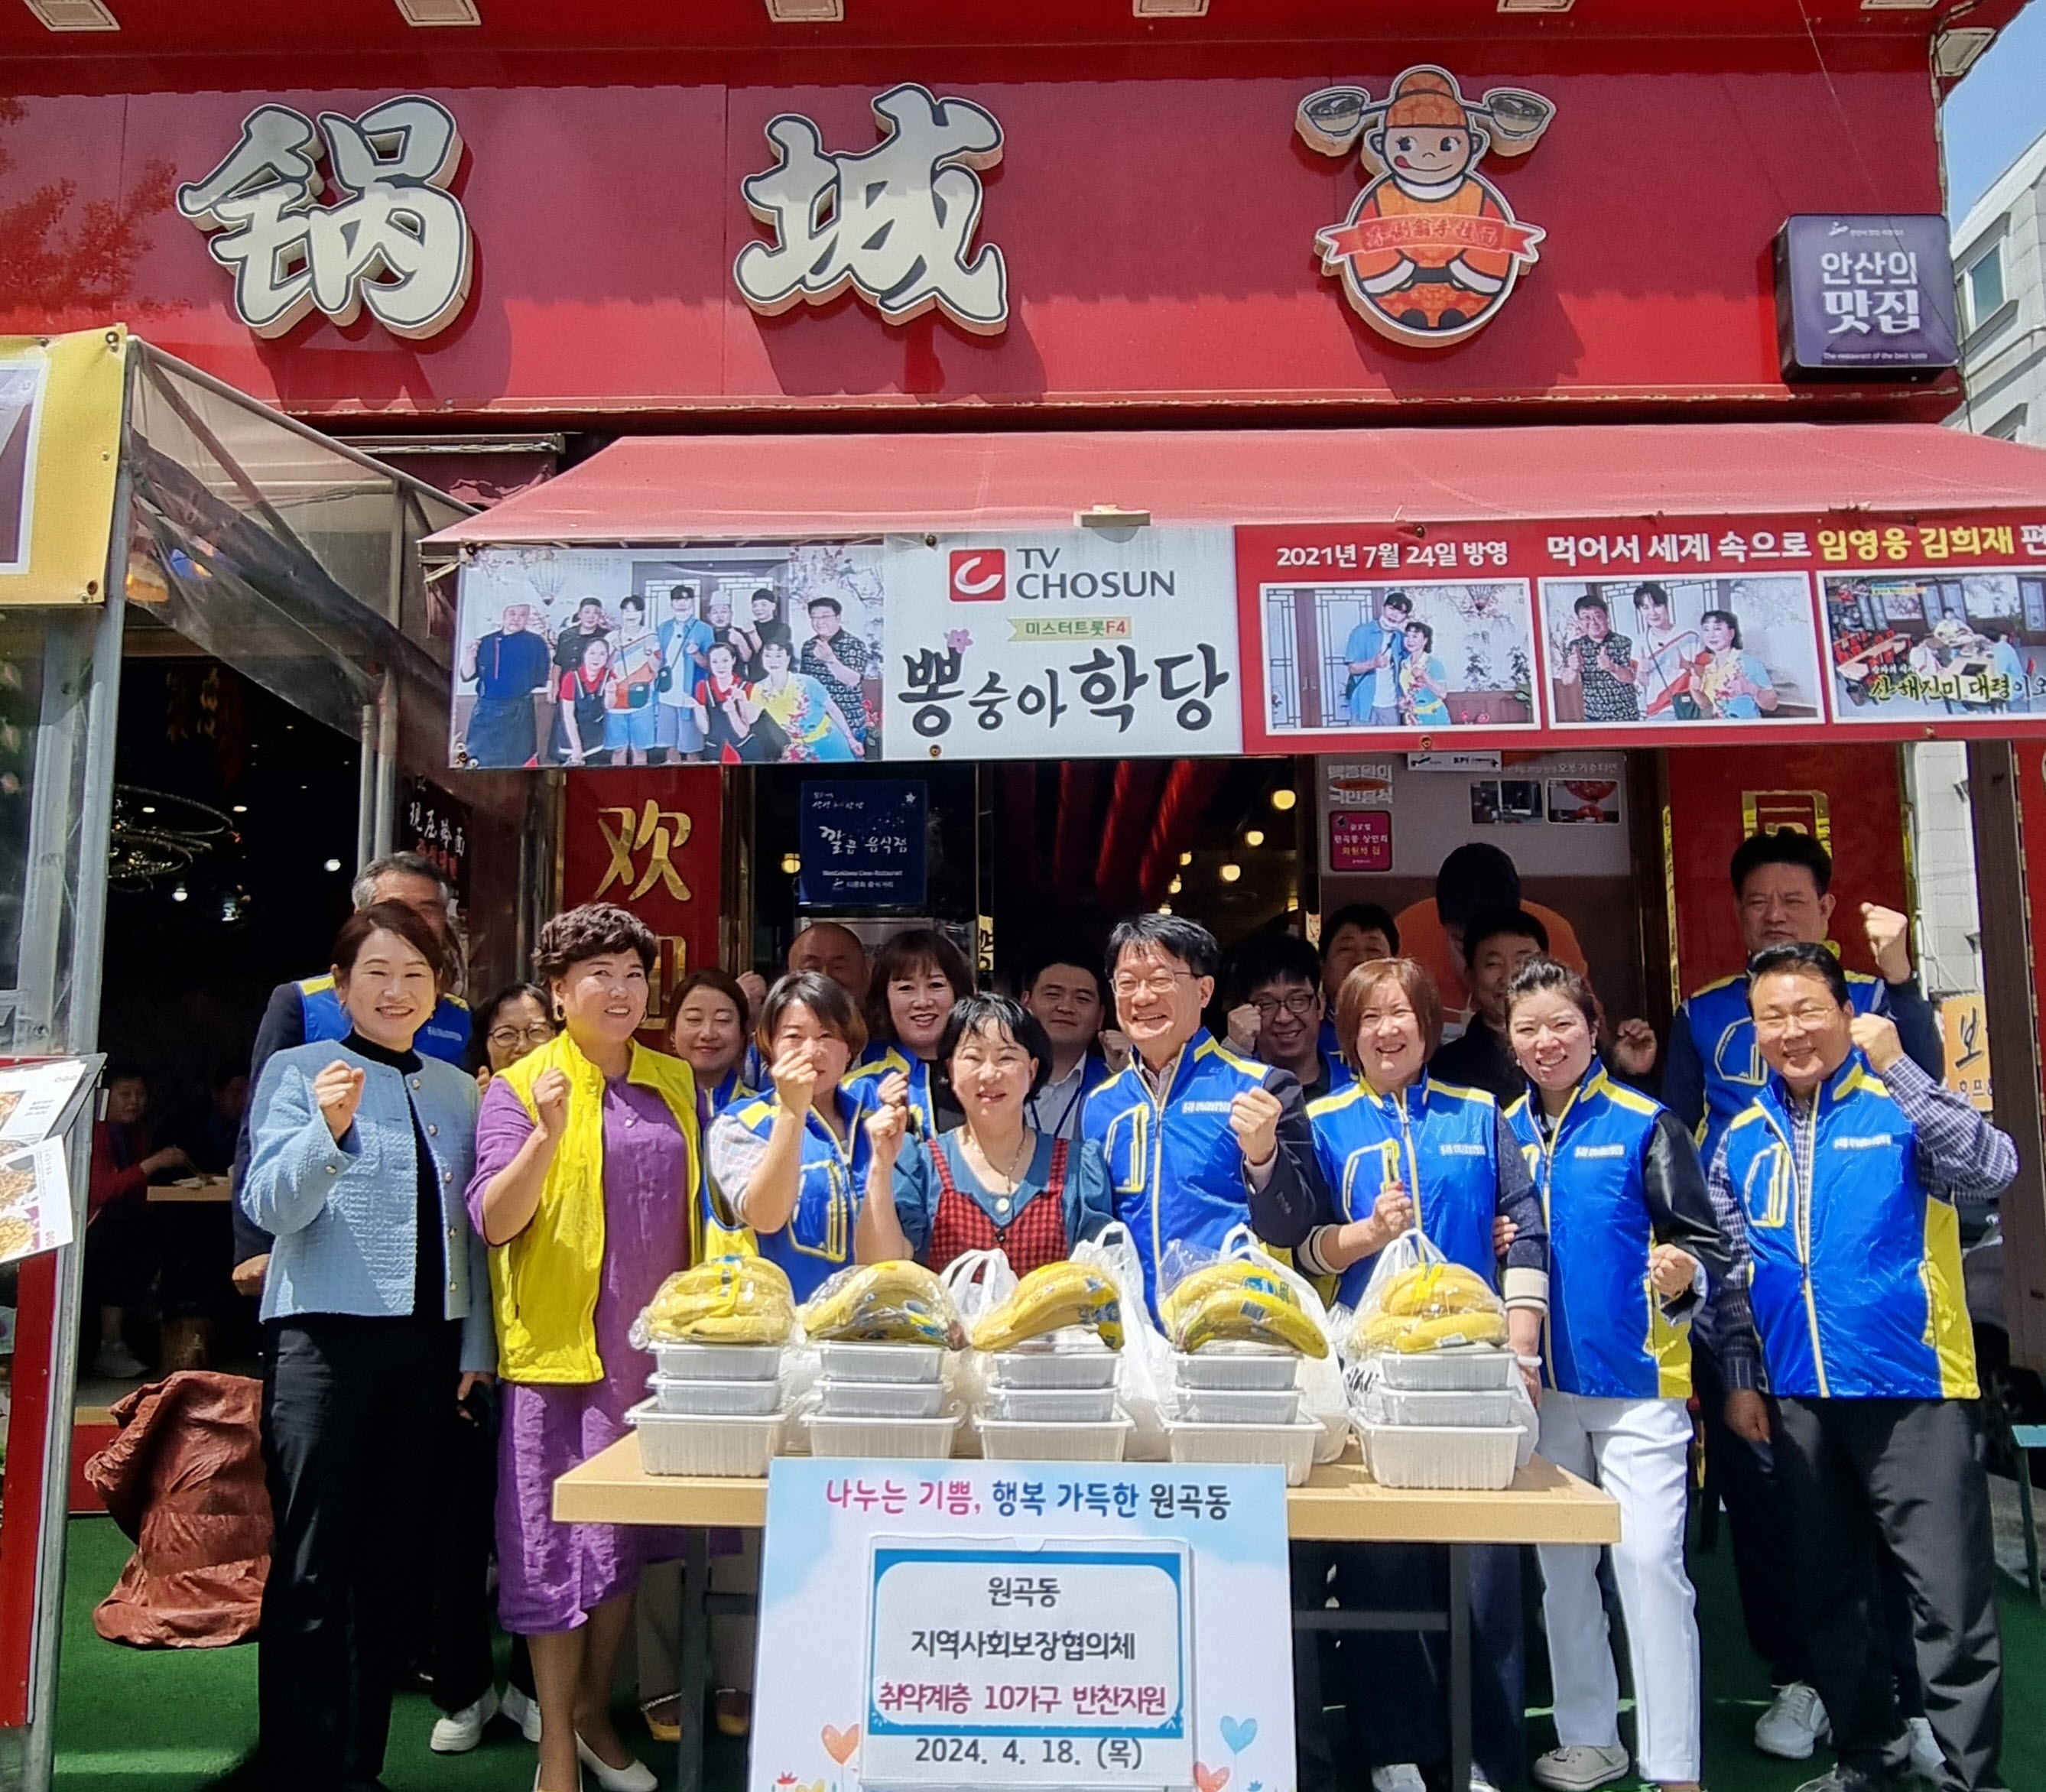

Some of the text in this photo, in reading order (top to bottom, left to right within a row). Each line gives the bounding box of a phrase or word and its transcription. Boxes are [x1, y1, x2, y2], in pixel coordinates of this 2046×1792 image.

[1821, 252, 1918, 285] 안산의
[1822, 290, 1921, 335] 맛집
[1016, 547, 1060, 569] TV
[1277, 541, 1508, 568] 2021년 7월 24일 방영
[1547, 534, 1641, 567] 먹어서
[1648, 533, 1711, 563] 세계
[1718, 531, 1812, 563] 속으로
[1817, 528, 1912, 561] 임영웅
[1919, 526, 2015, 559] 김희재
[1016, 570, 1175, 599] CHOSUN
[1025, 620, 1127, 637] 미스터트롯F4
[898, 643, 1229, 738] 뽕숭아학당
[1870, 674, 1961, 701] 산해진미
[819, 826, 908, 855] 깔끔 음식점
[827, 1479, 1231, 1519] 나누는 기쁨, 행복 가득한 원곡동
[988, 1576, 1060, 1607] 원곡동
[911, 1631, 1135, 1661] 지역사회보장협의체
[878, 1682, 1167, 1716] 취약계층 10가구 반찬지원
[915, 1738, 1142, 1770] 2024. 4. 18. (목)
